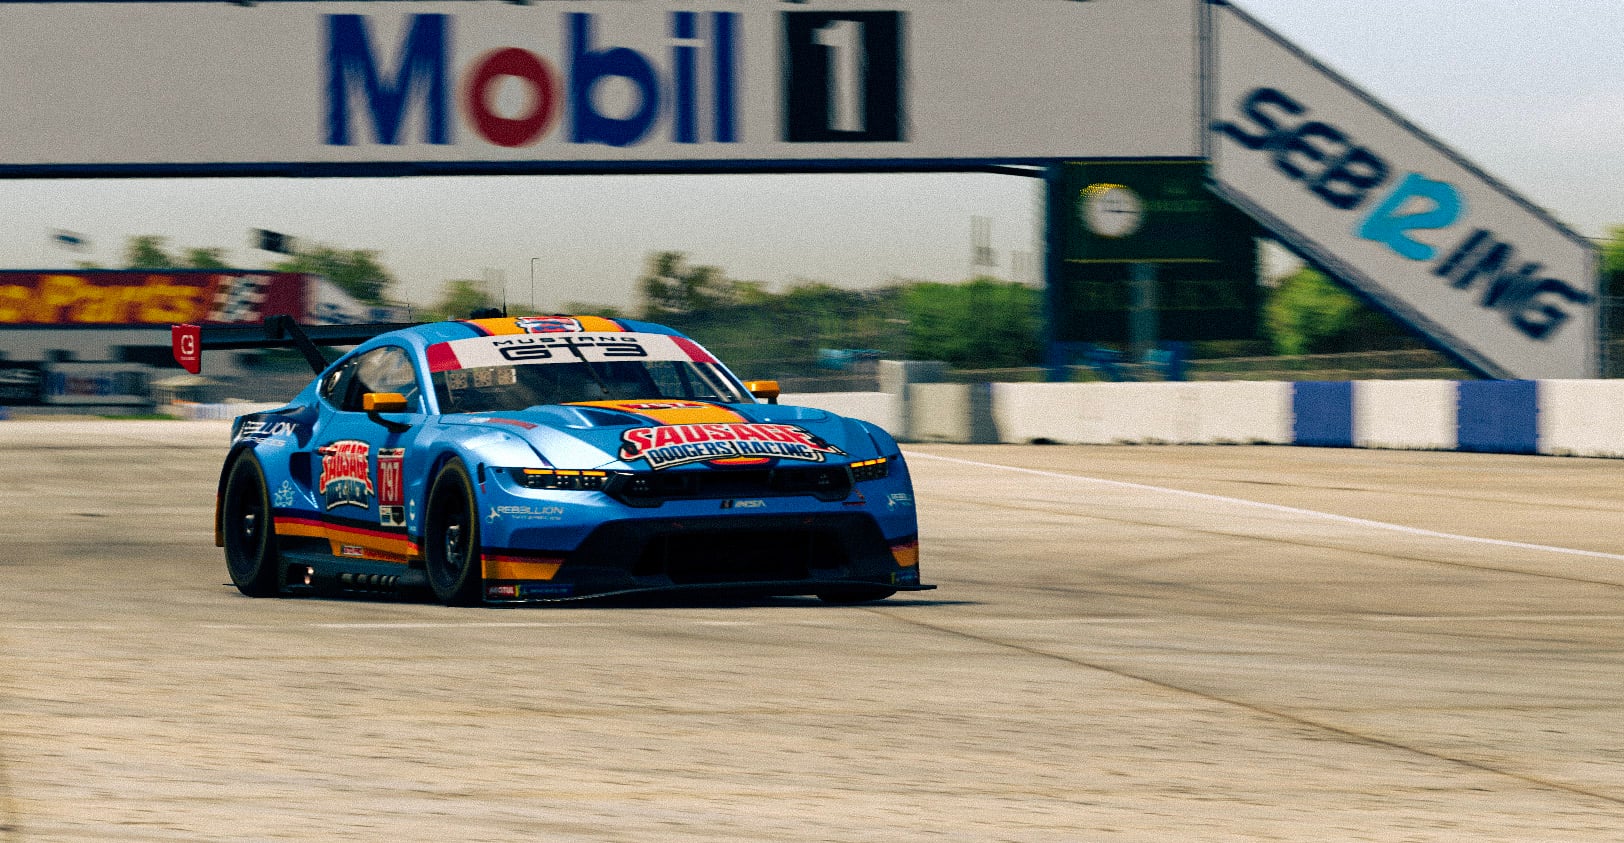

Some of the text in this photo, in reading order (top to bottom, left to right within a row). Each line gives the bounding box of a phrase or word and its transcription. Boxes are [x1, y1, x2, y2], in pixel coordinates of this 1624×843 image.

[322, 12, 866, 146] Mobil 1
[1212, 88, 1592, 341] SEBRING
[492, 336, 637, 346] MUSTANG
[499, 343, 648, 361] GT3
[621, 424, 832, 458] SAUSAGE
[650, 440, 814, 465] DODGERS RACING
[381, 462, 399, 501] 797
